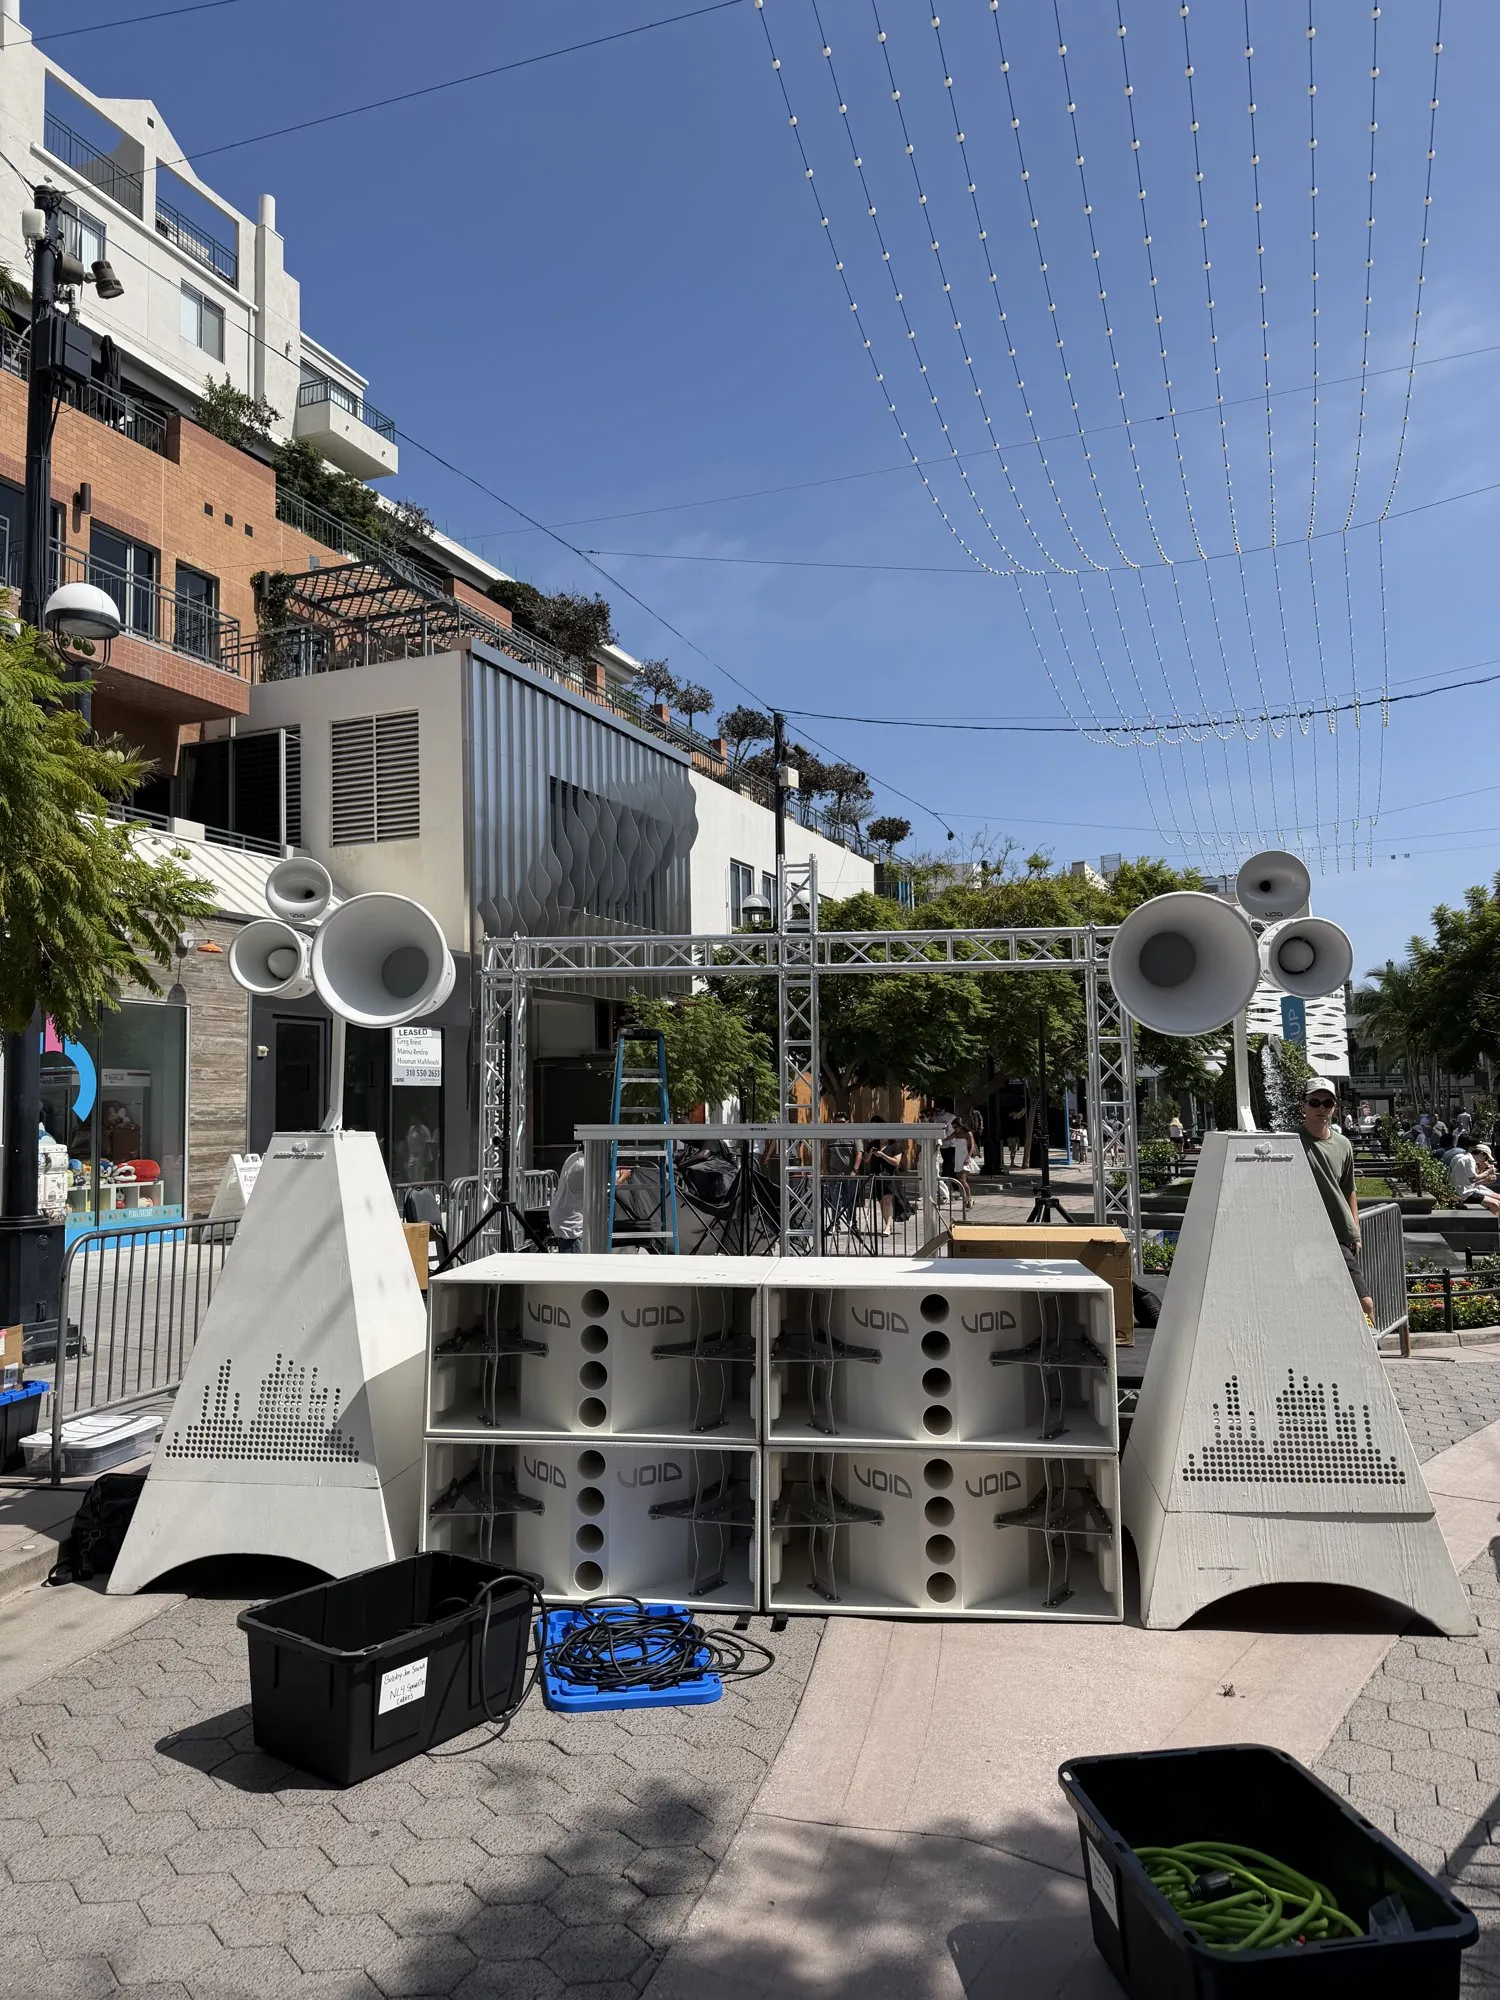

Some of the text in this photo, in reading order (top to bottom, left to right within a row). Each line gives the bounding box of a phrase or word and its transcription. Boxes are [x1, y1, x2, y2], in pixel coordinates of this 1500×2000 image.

[406, 1069, 415, 1077] 310
[416, 1069, 427, 1077] 550
[528, 1301, 571, 1328] VOID
[620, 1305, 685, 1328] VOID
[851, 1306, 910, 1334] VOID
[961, 1310, 1017, 1334] VOID
[523, 1455, 567, 1489] VOID
[617, 1461, 683, 1489] VOID
[853, 1464, 913, 1499] VOID
[965, 1470, 1021, 1498] VOID
